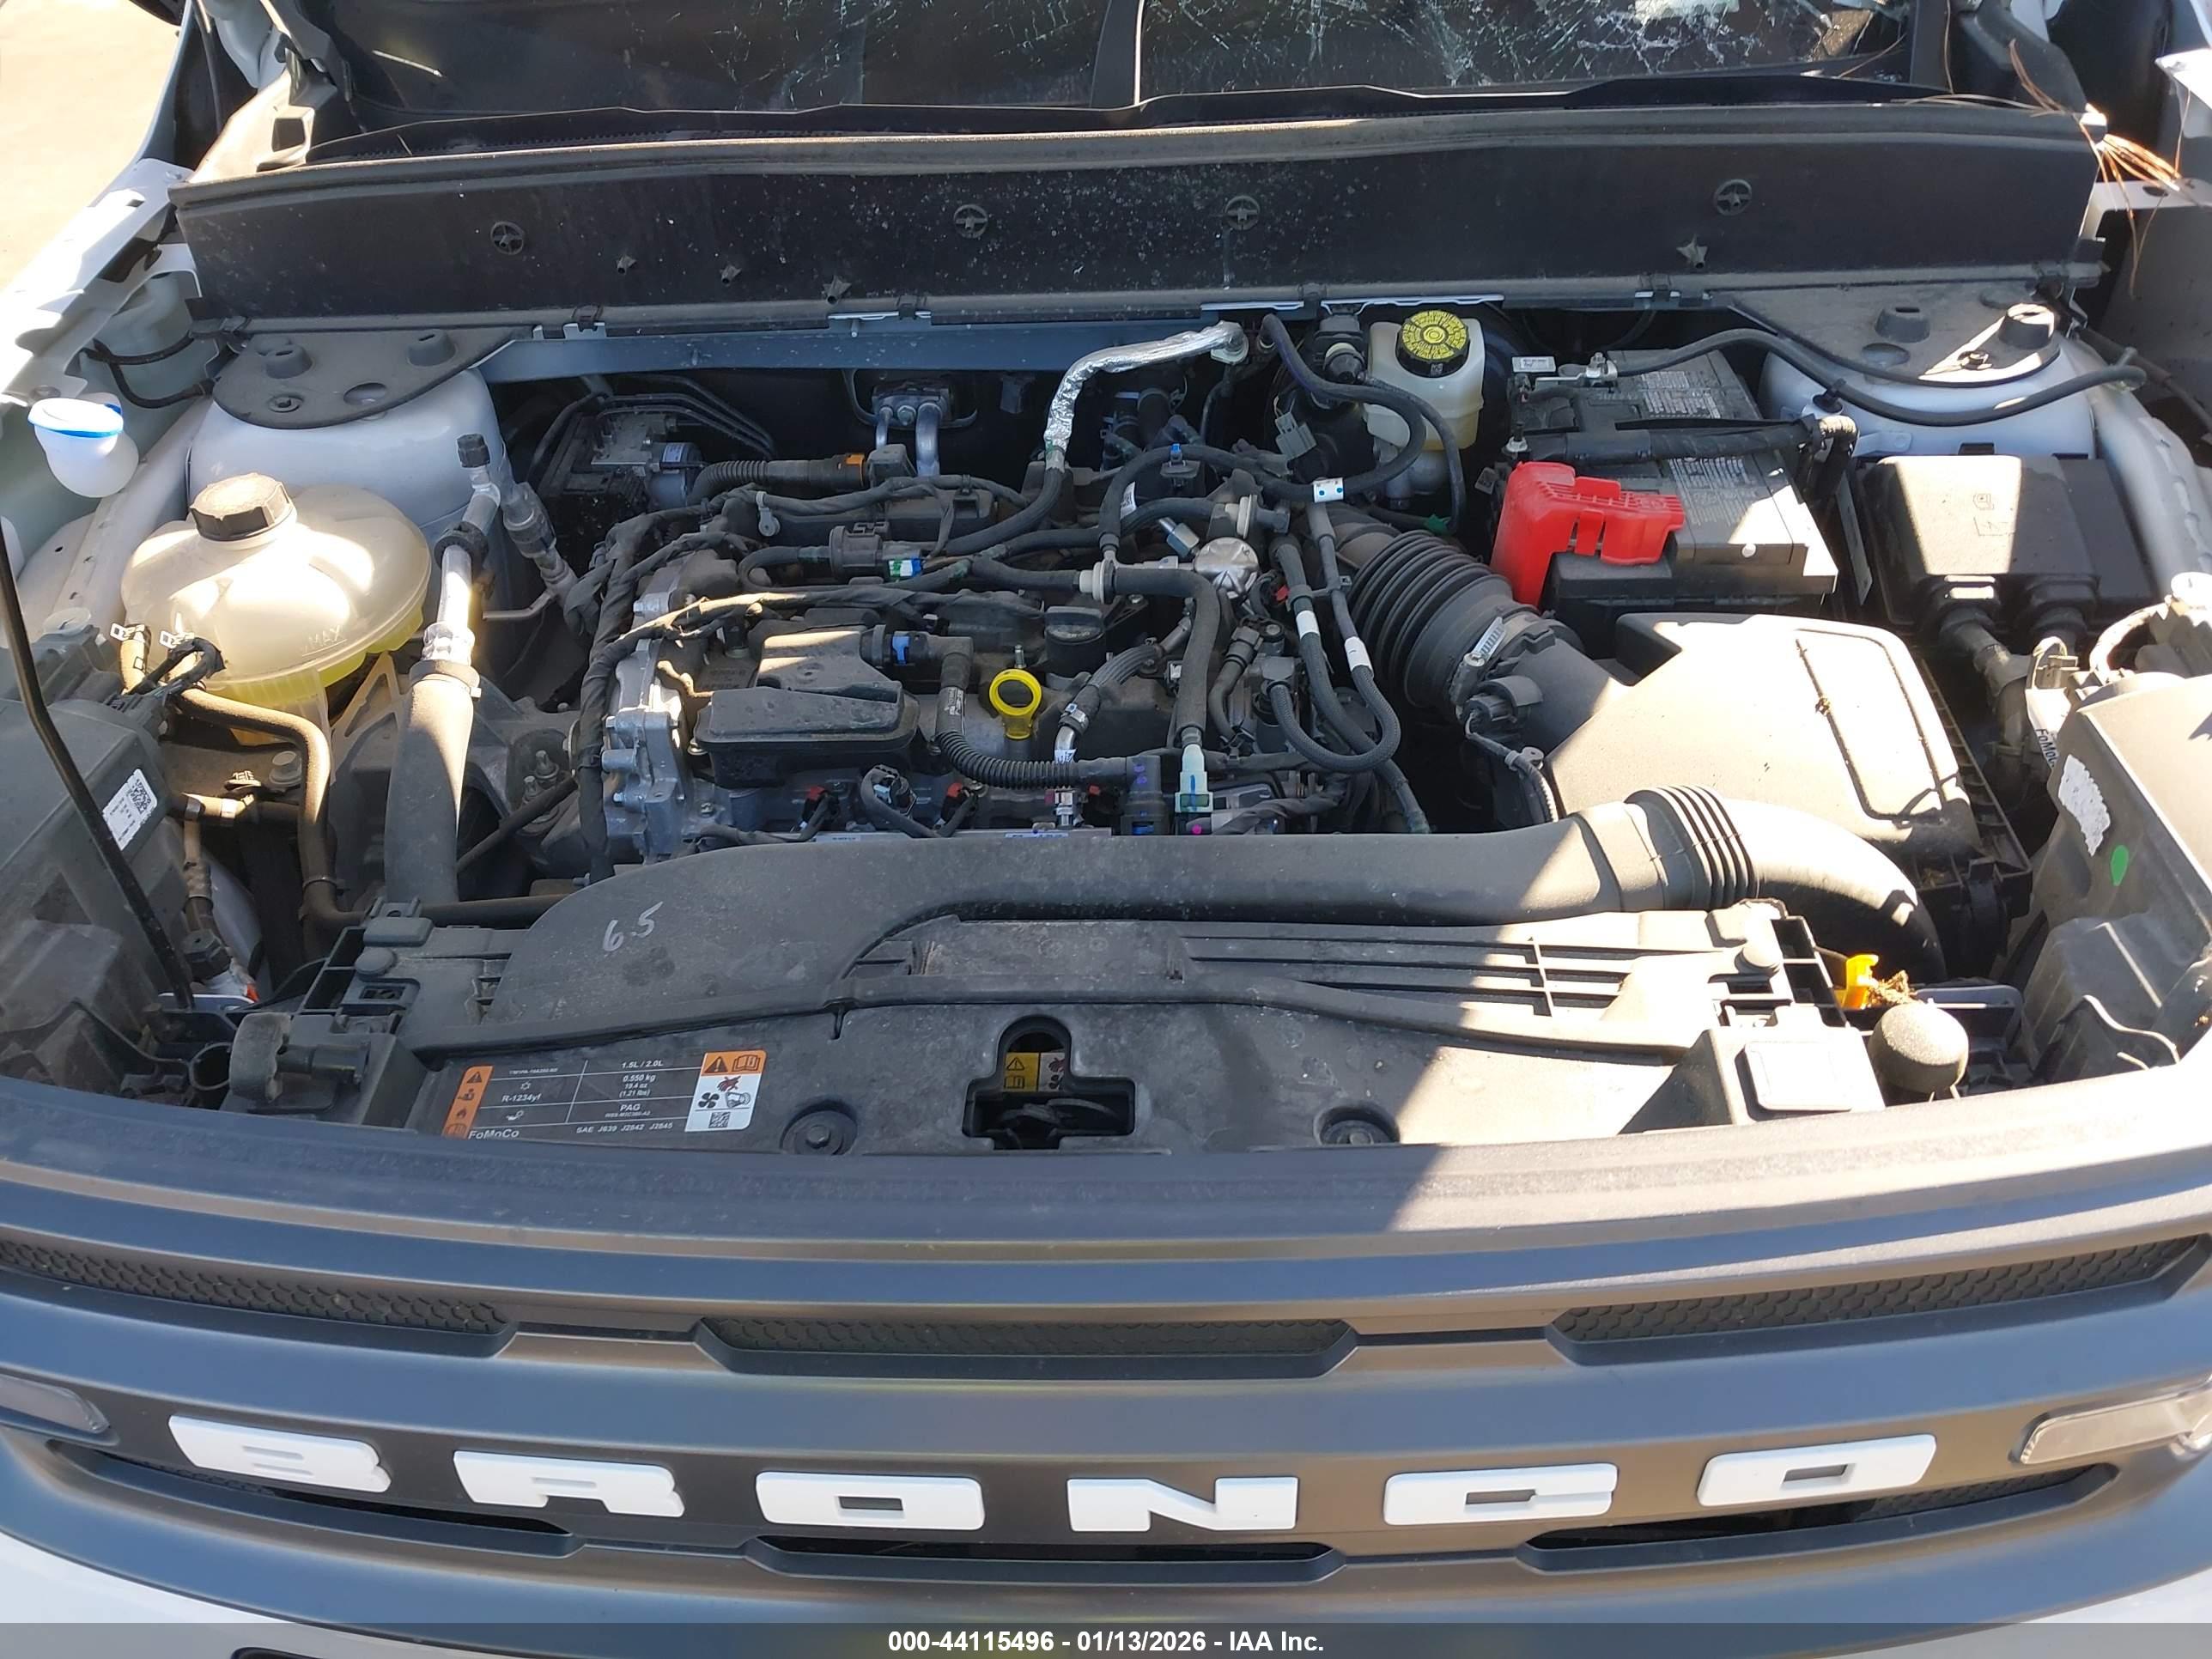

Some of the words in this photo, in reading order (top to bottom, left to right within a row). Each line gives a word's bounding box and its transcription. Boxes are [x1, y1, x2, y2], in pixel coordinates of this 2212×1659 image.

[501, 1093, 542, 1103] R-1234yf
[468, 1128, 520, 1140] FoMoCo
[169, 1415, 1937, 1533] BRONCO
